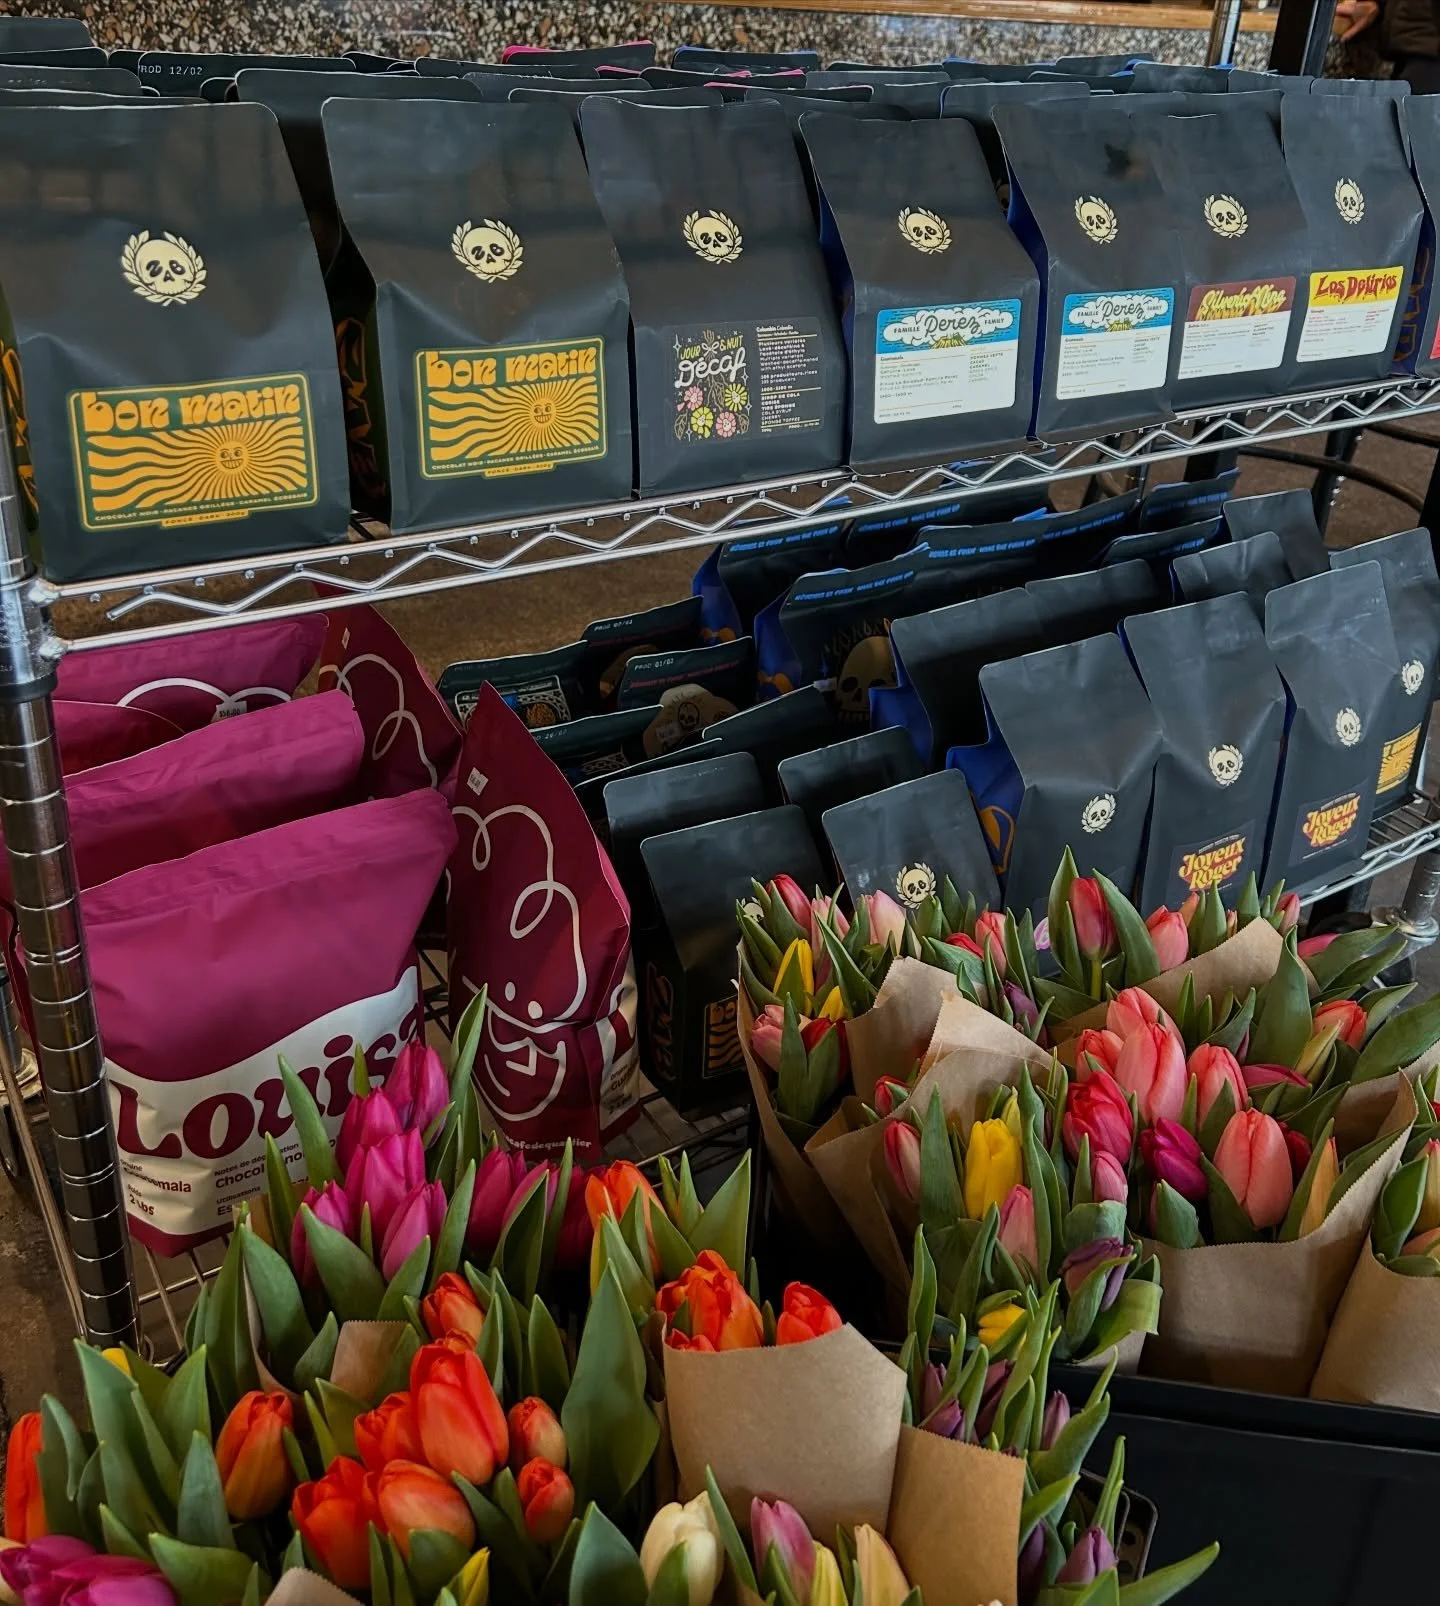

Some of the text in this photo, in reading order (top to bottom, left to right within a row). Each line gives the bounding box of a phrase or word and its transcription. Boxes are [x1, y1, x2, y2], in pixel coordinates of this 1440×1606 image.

[170, 66, 203, 75] 12/02
[1102, 301, 1145, 320] Perez
[924, 315, 981, 337] Perez
[681, 345, 700, 360] JOUR
[426, 347, 596, 388] bon matin
[675, 347, 746, 388] Décaf
[81, 384, 301, 432] bon matin
[95, 512, 137, 521] CHOCOLAT
[239, 497, 272, 505] CARAMEL
[1303, 795, 1360, 834] Joyeux
[1178, 837, 1246, 878] Joyeux
[1189, 856, 1242, 889] Roger
[214, 1162, 238, 1176] Notes
[240, 1159, 250, 1168] de
[130, 1194, 136, 1204] 2
[216, 1186, 260, 1204] Utilisations
